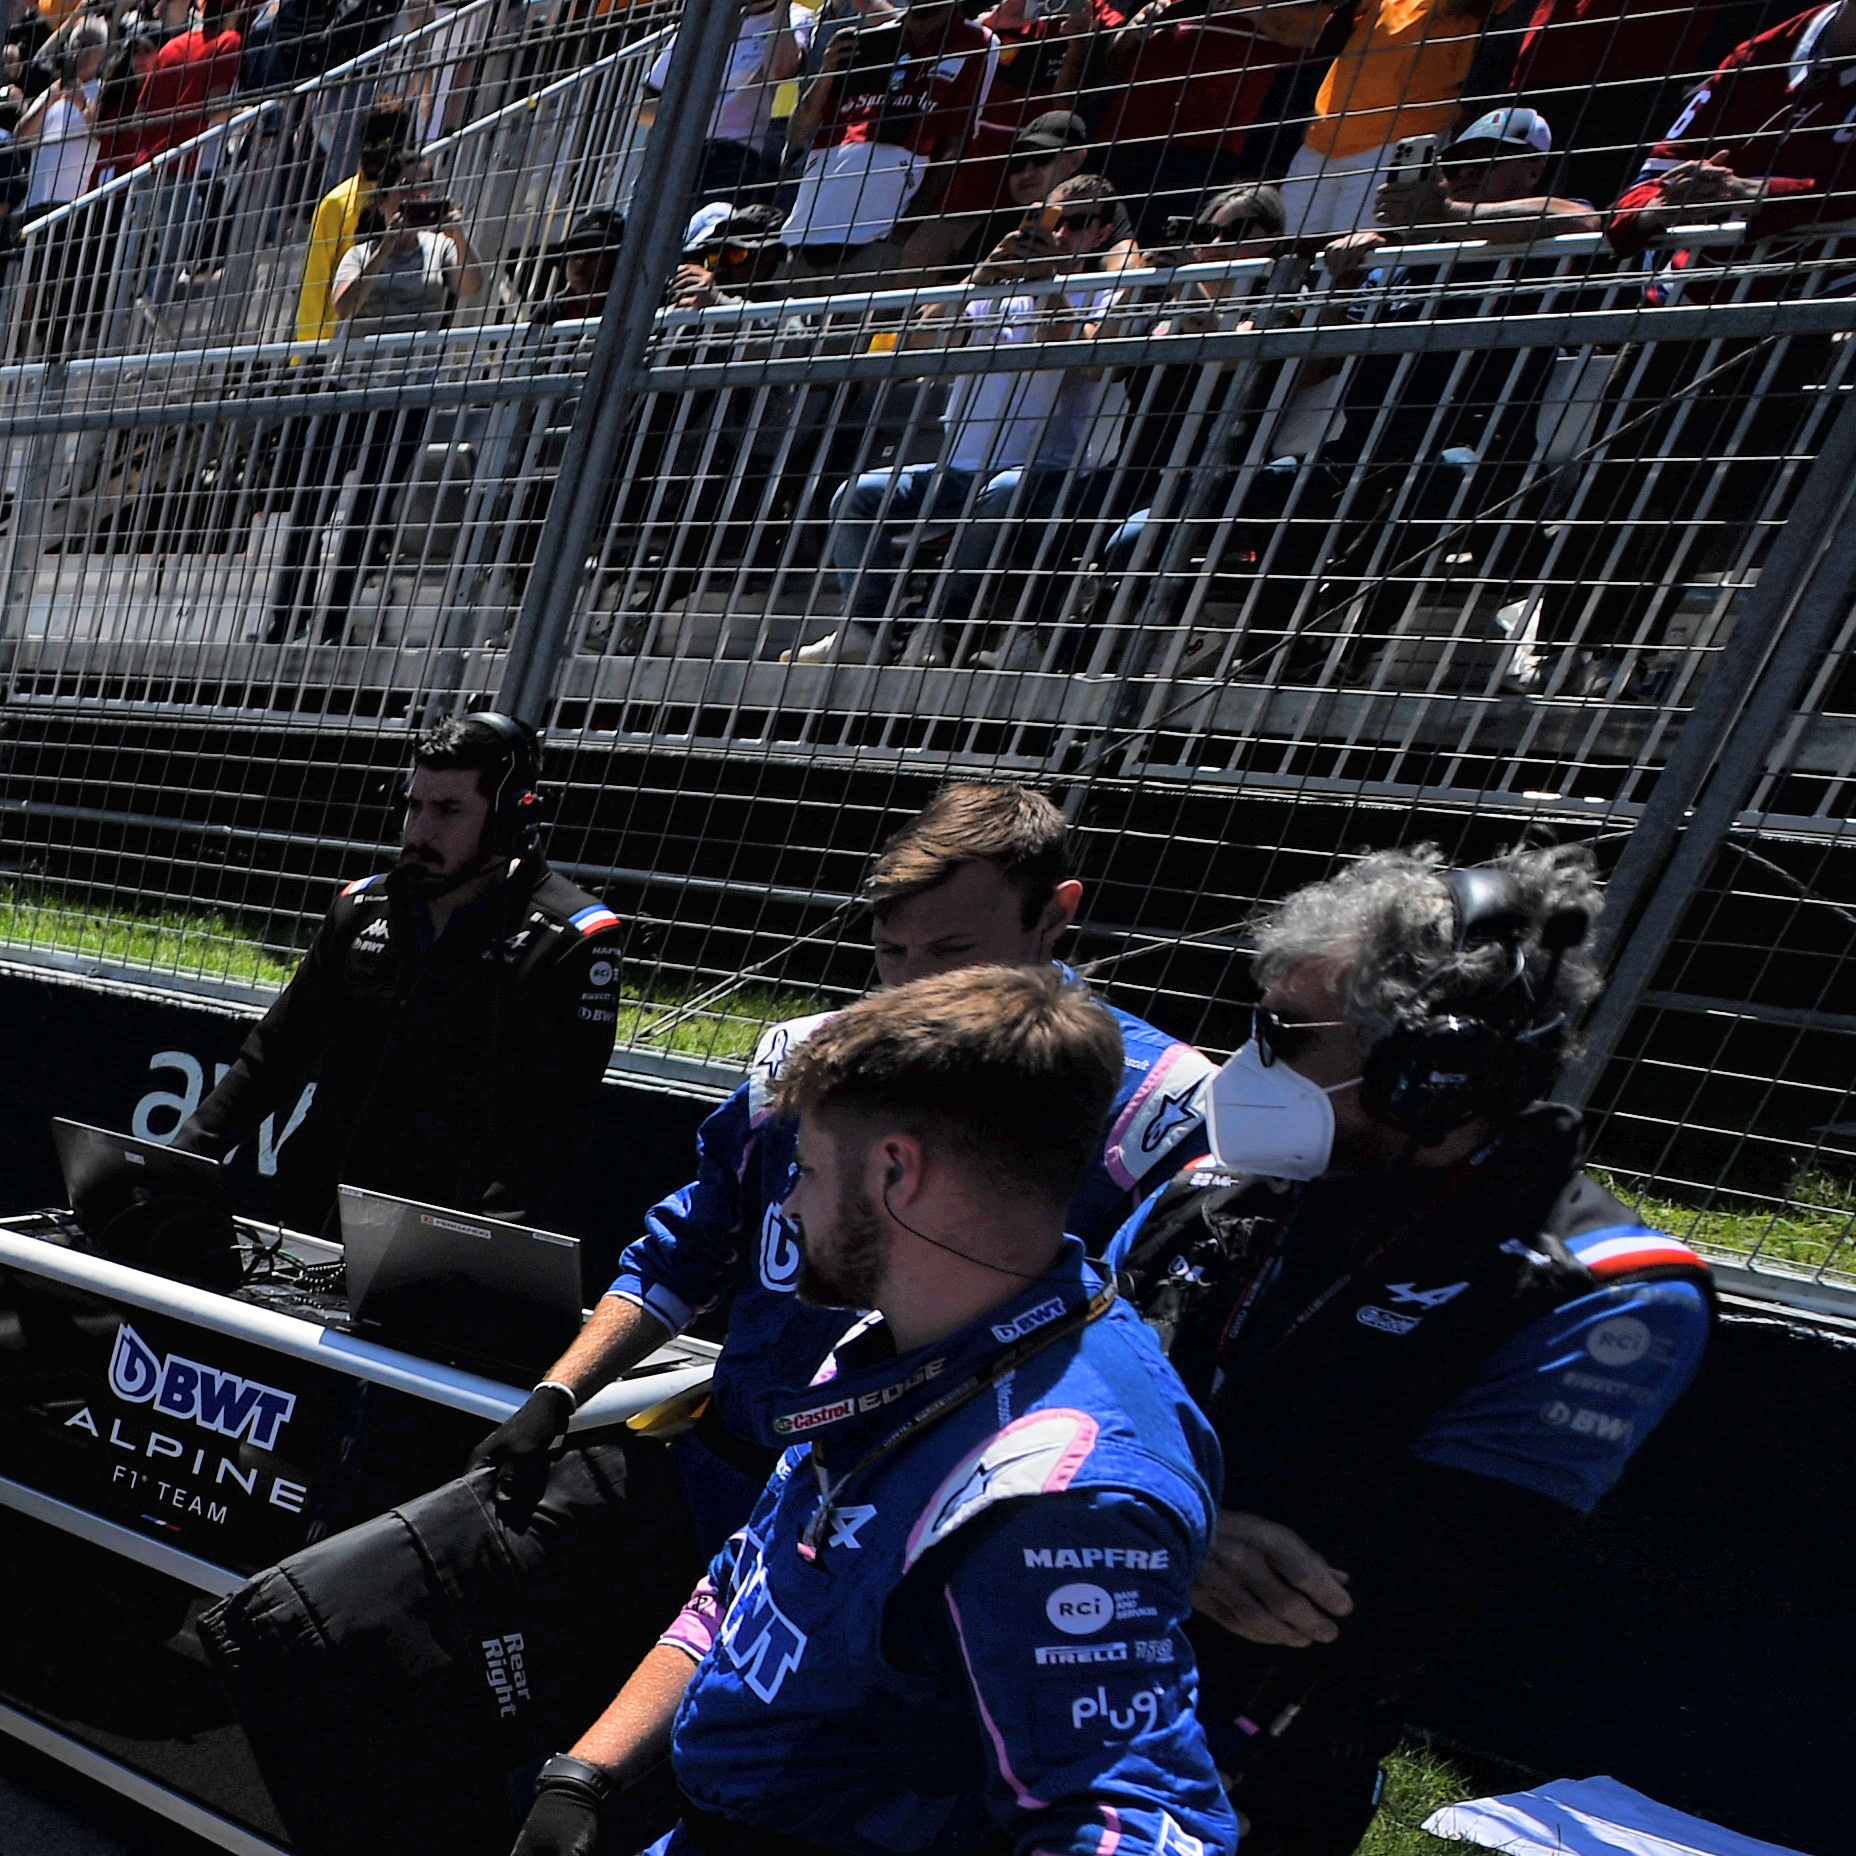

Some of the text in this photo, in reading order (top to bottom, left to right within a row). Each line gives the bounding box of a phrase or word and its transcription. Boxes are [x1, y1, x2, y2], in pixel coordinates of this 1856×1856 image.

[153, 1353, 297, 1451] BWT
[794, 1400, 852, 1431] Castrol
[64, 1407, 308, 1514] ALPINE
[158, 1481, 228, 1525] TEAM
[1023, 1548, 1170, 1570] MAPFRE
[482, 1639, 518, 1718] Right
[503, 1633, 530, 1700] Rear
[1035, 1642, 1127, 1665] PIRELLI
[1072, 1686, 1158, 1736] plug
